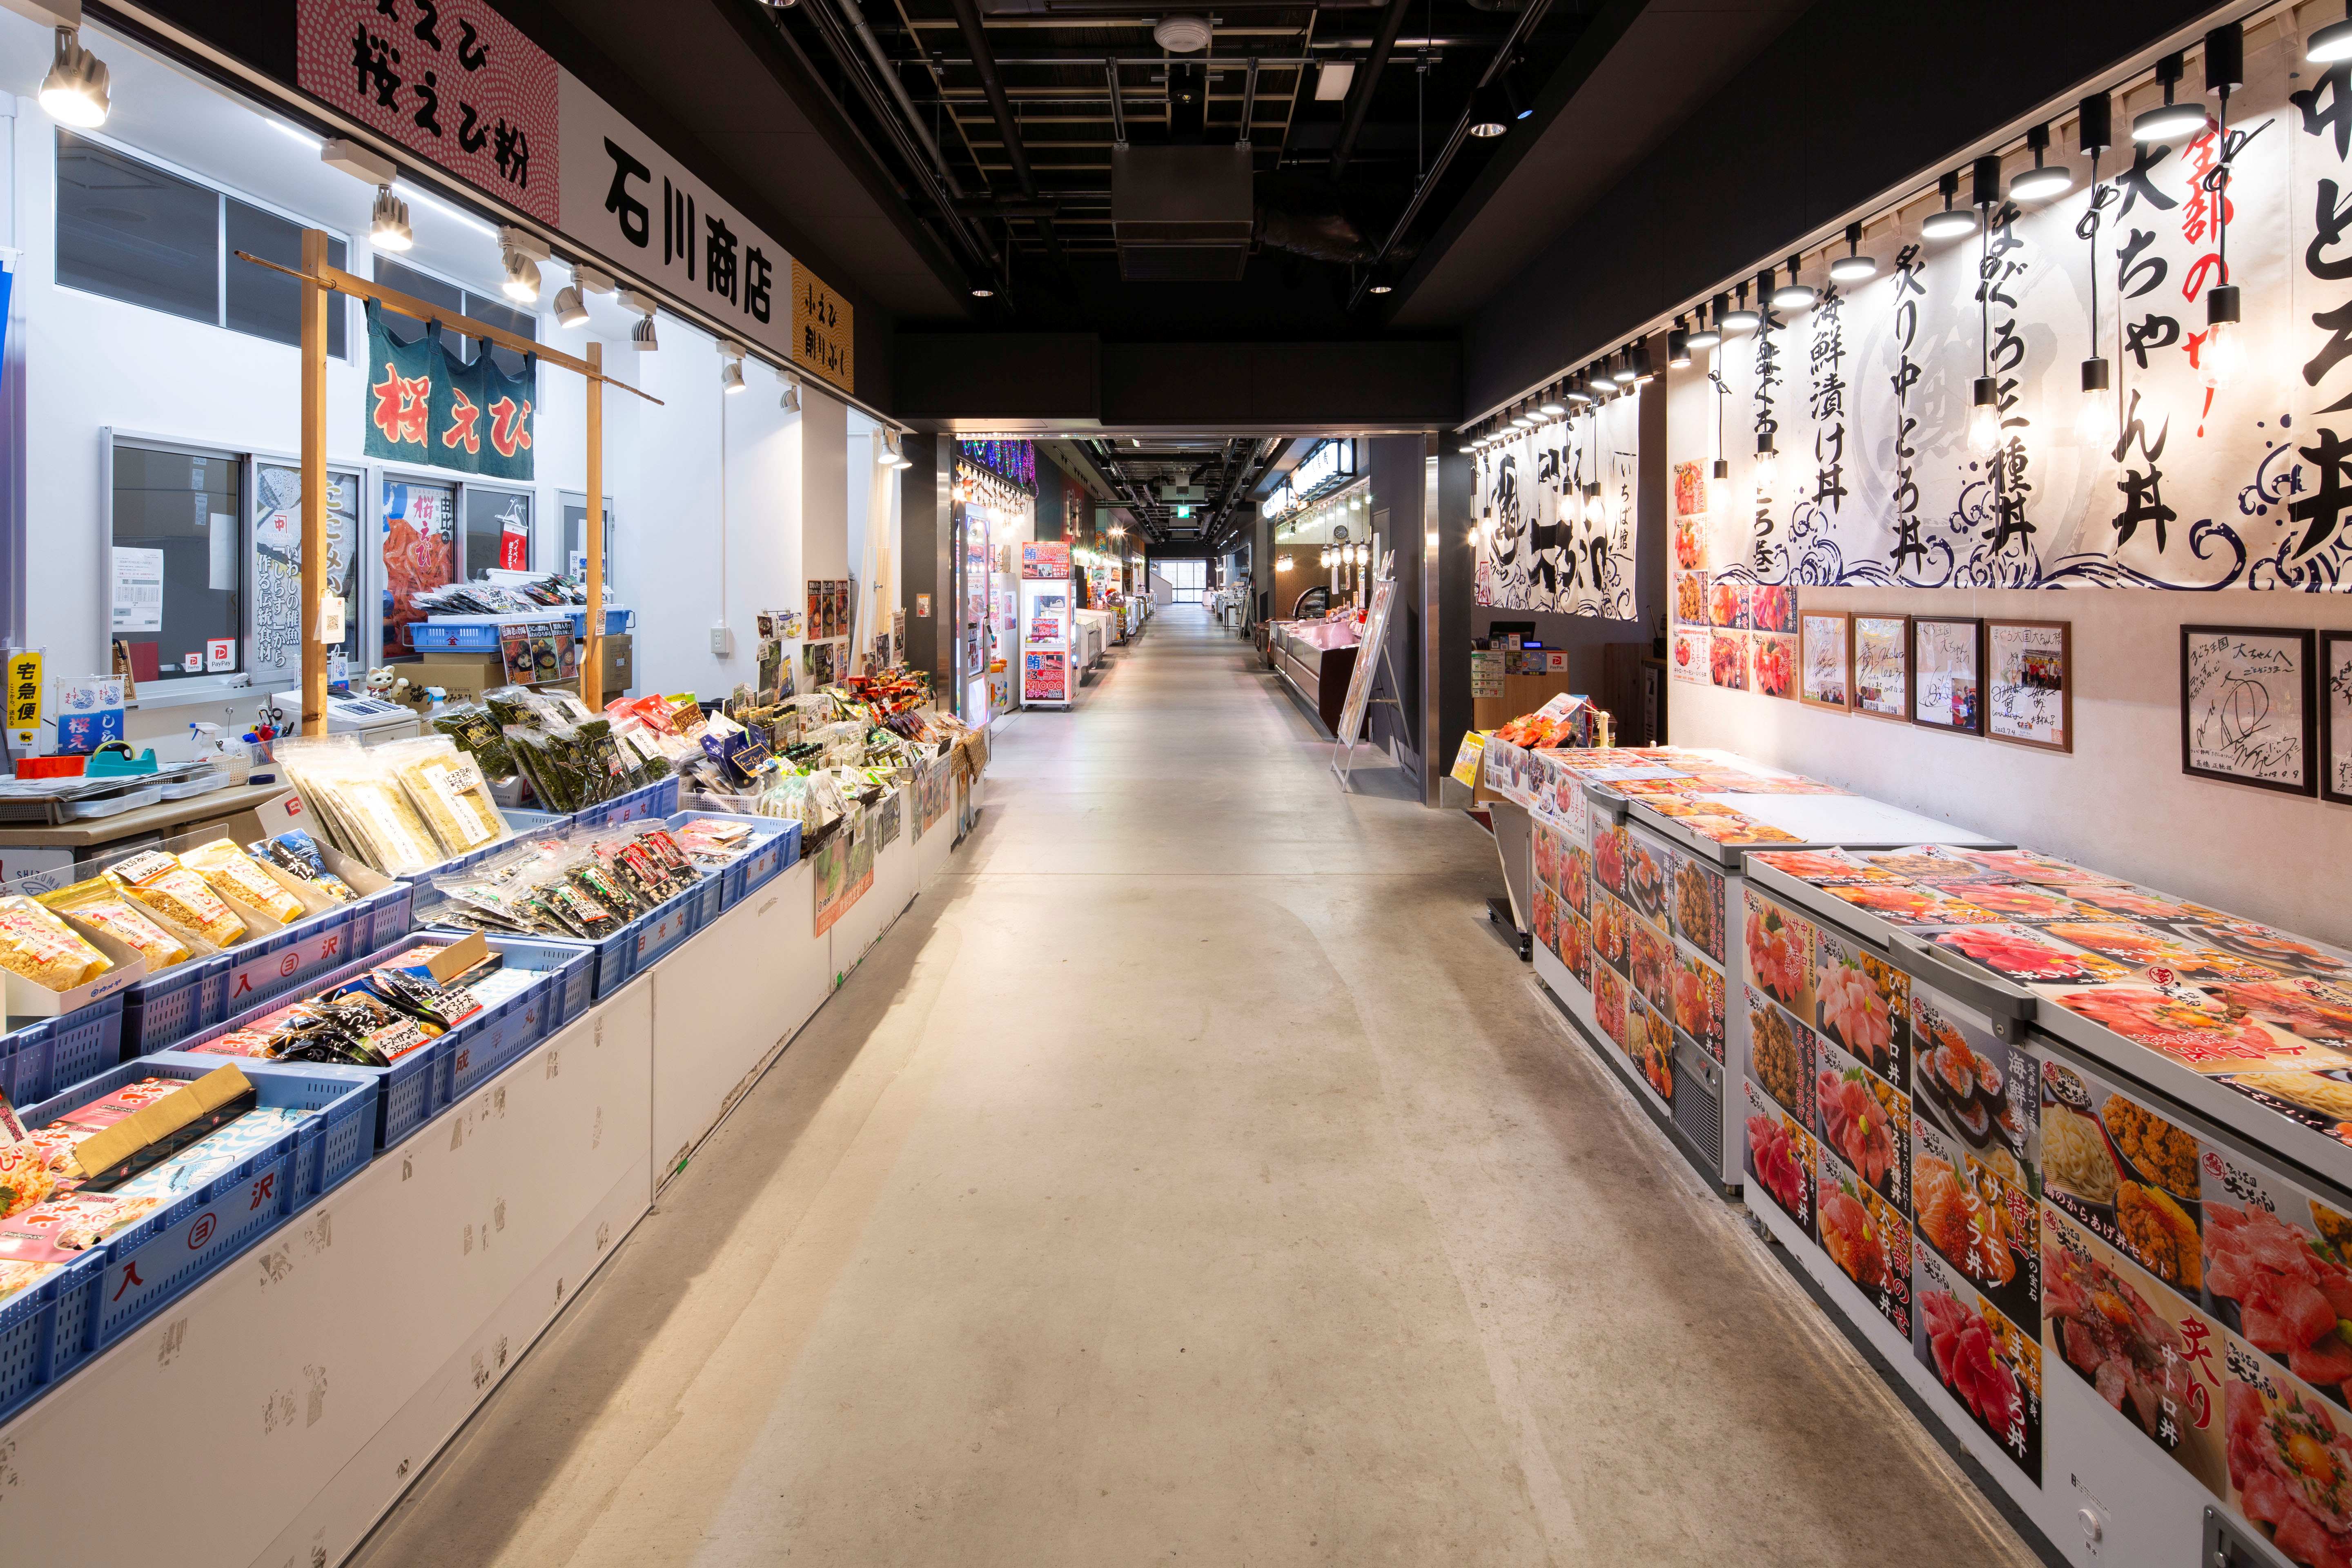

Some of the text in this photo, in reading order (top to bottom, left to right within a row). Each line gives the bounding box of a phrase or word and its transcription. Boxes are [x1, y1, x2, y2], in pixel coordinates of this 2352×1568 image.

[351, 22, 530, 189] 桜えび粉
[604, 135, 772, 325] 石川商店
[805, 283, 837, 328] 小えび
[2113, 141, 2180, 556] 大ちゃん丼
[372, 362, 532, 457] 桜えび
[1810, 280, 1848, 514] 海鮮漬け丼
[1890, 243, 1929, 577] 炙り中とろ丼
[413, 494, 434, 567] 桜えび
[440, 497, 452, 531] 由比
[1619, 463, 1633, 550] いちば館
[257, 554, 272, 662] 作る伝統食材
[272, 545, 286, 667] 「しらす」から
[286, 545, 300, 645] いわしの稚魚
[16, 662, 36, 720] 宅急便
[1027, 655, 1040, 670] 鮪
[1740, 634, 1748, 674] 炙り
[637, 911, 684, 953] 日光丸
[1664, 942, 1675, 996] 炙り
[1783, 914, 1793, 976] いくら丼
[1792, 916, 1801, 978] サーモン
[380, 1027, 419, 1049] チーズかつお
[440, 994, 474, 1018] まぐろチーズ
[1705, 969, 1714, 1055] 大ちゃん丼
[1713, 976, 1725, 1063] 全部のせ
[1887, 971, 1901, 1086] びんトロ丼
[1796, 1025, 1805, 1120] まぐろ唐揚げ
[1806, 1029, 1815, 1132] 大ちゃん名物
[2056, 1077, 2092, 1110] 大ちゃん
[1796, 1132, 1809, 1227] まぐろ丼
[1889, 1093, 1901, 1205] まぐろ3種丼
[2222, 1176, 2275, 1214] 大ちゃん
[1879, 1204, 1892, 1317] 大ちゃん丼
[1966, 1164, 1984, 1280] イクラ丼
[1984, 1174, 2003, 1289] サーモン
[2006, 1187, 2029, 1261] 特上
[2043, 1181, 2168, 1278] 鶏のからあげ丼セット
[2056, 1230, 2092, 1265] 大ちゃん
[1893, 1218, 1910, 1336] 全部のせ
[2007, 1332, 2027, 1458] まぐろ丼
[2159, 1342, 2180, 1448] 中トロ丼
[2177, 1312, 2223, 1430] 炙り
[2227, 1351, 2279, 1402] 大ちゃん
[2085, 1541, 2098, 1558] 排水
